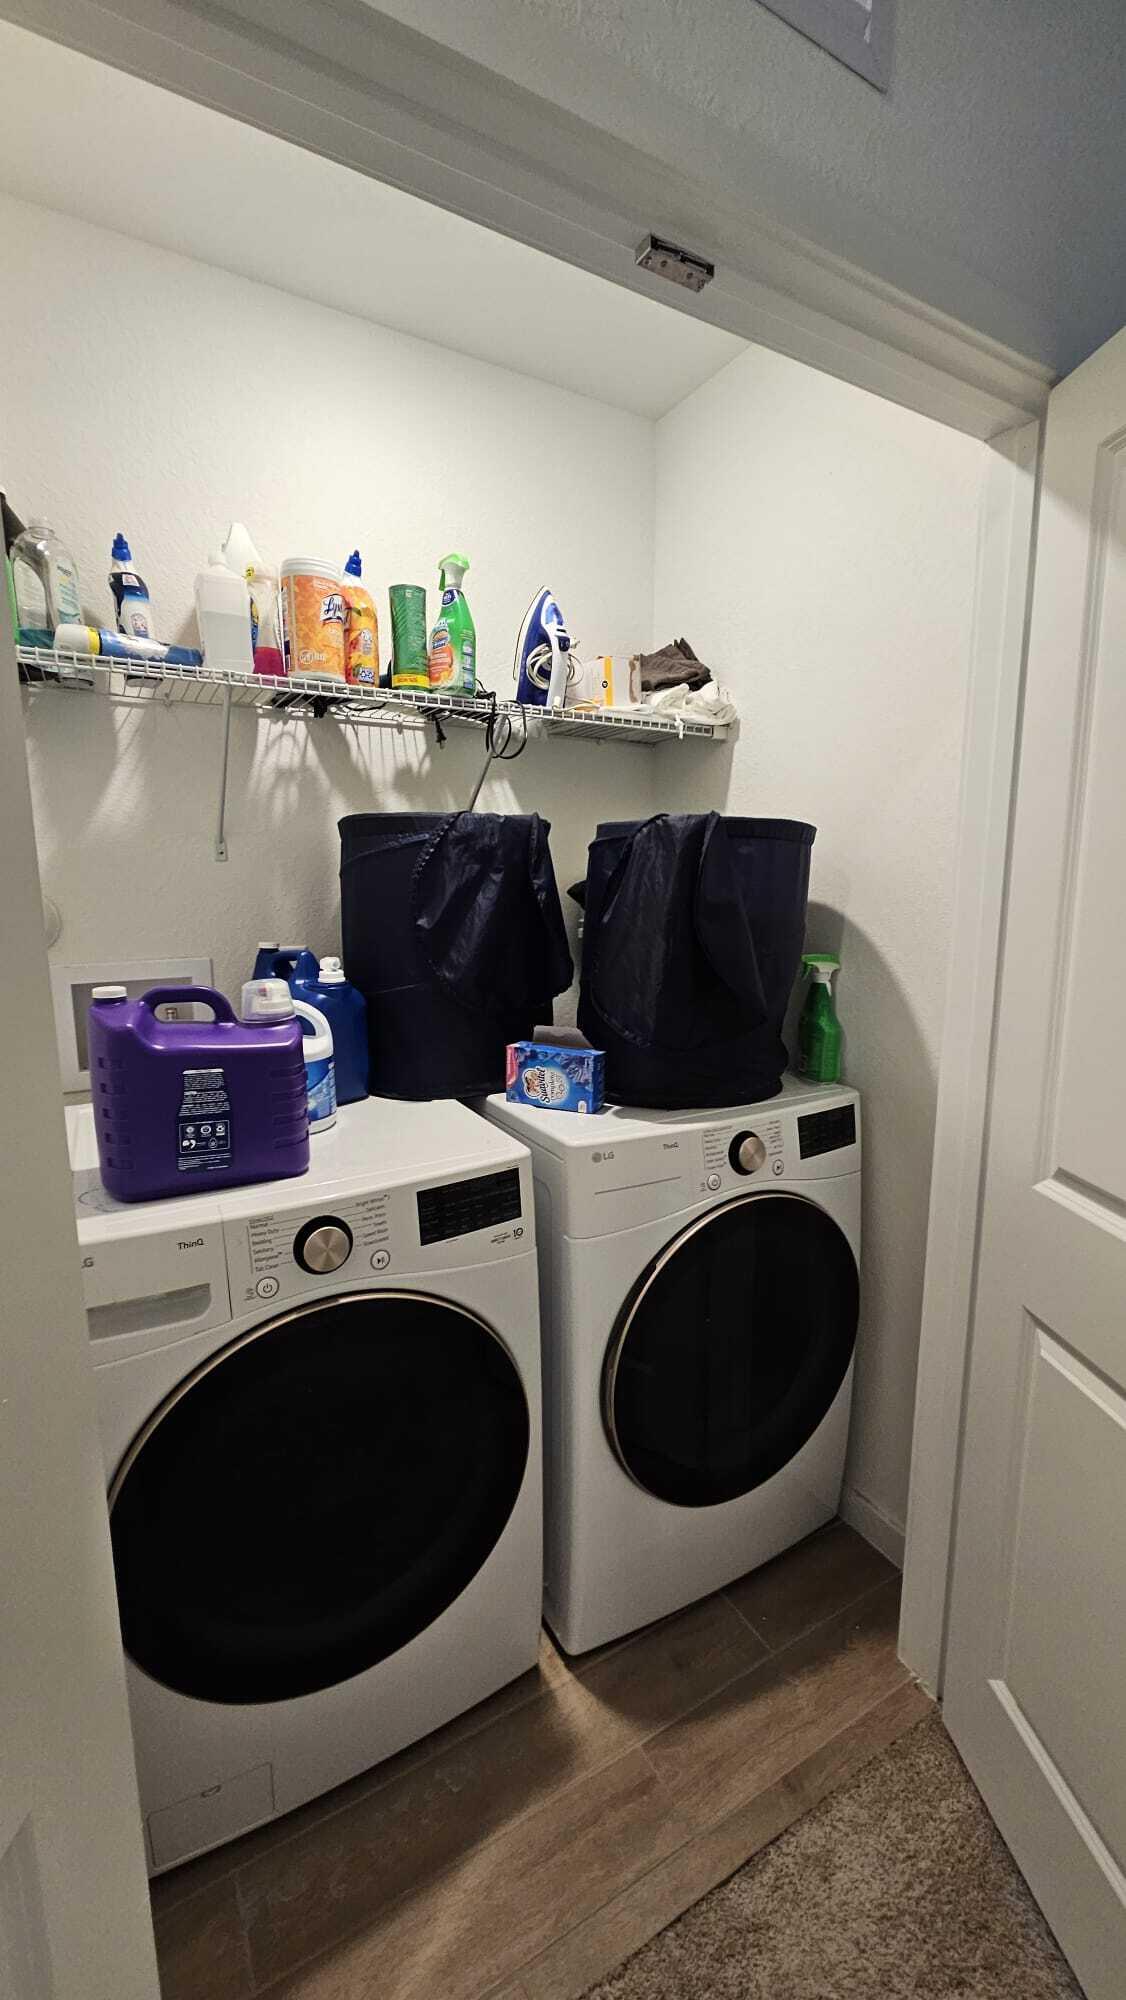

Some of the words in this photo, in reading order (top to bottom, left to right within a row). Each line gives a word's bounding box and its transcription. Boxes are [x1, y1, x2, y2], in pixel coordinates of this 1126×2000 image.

[323, 596, 343, 616] Lys
[537, 1067, 551, 1103] Suavitel
[603, 1151, 615, 1161] LG
[178, 1238, 204, 1250] ThinQ
